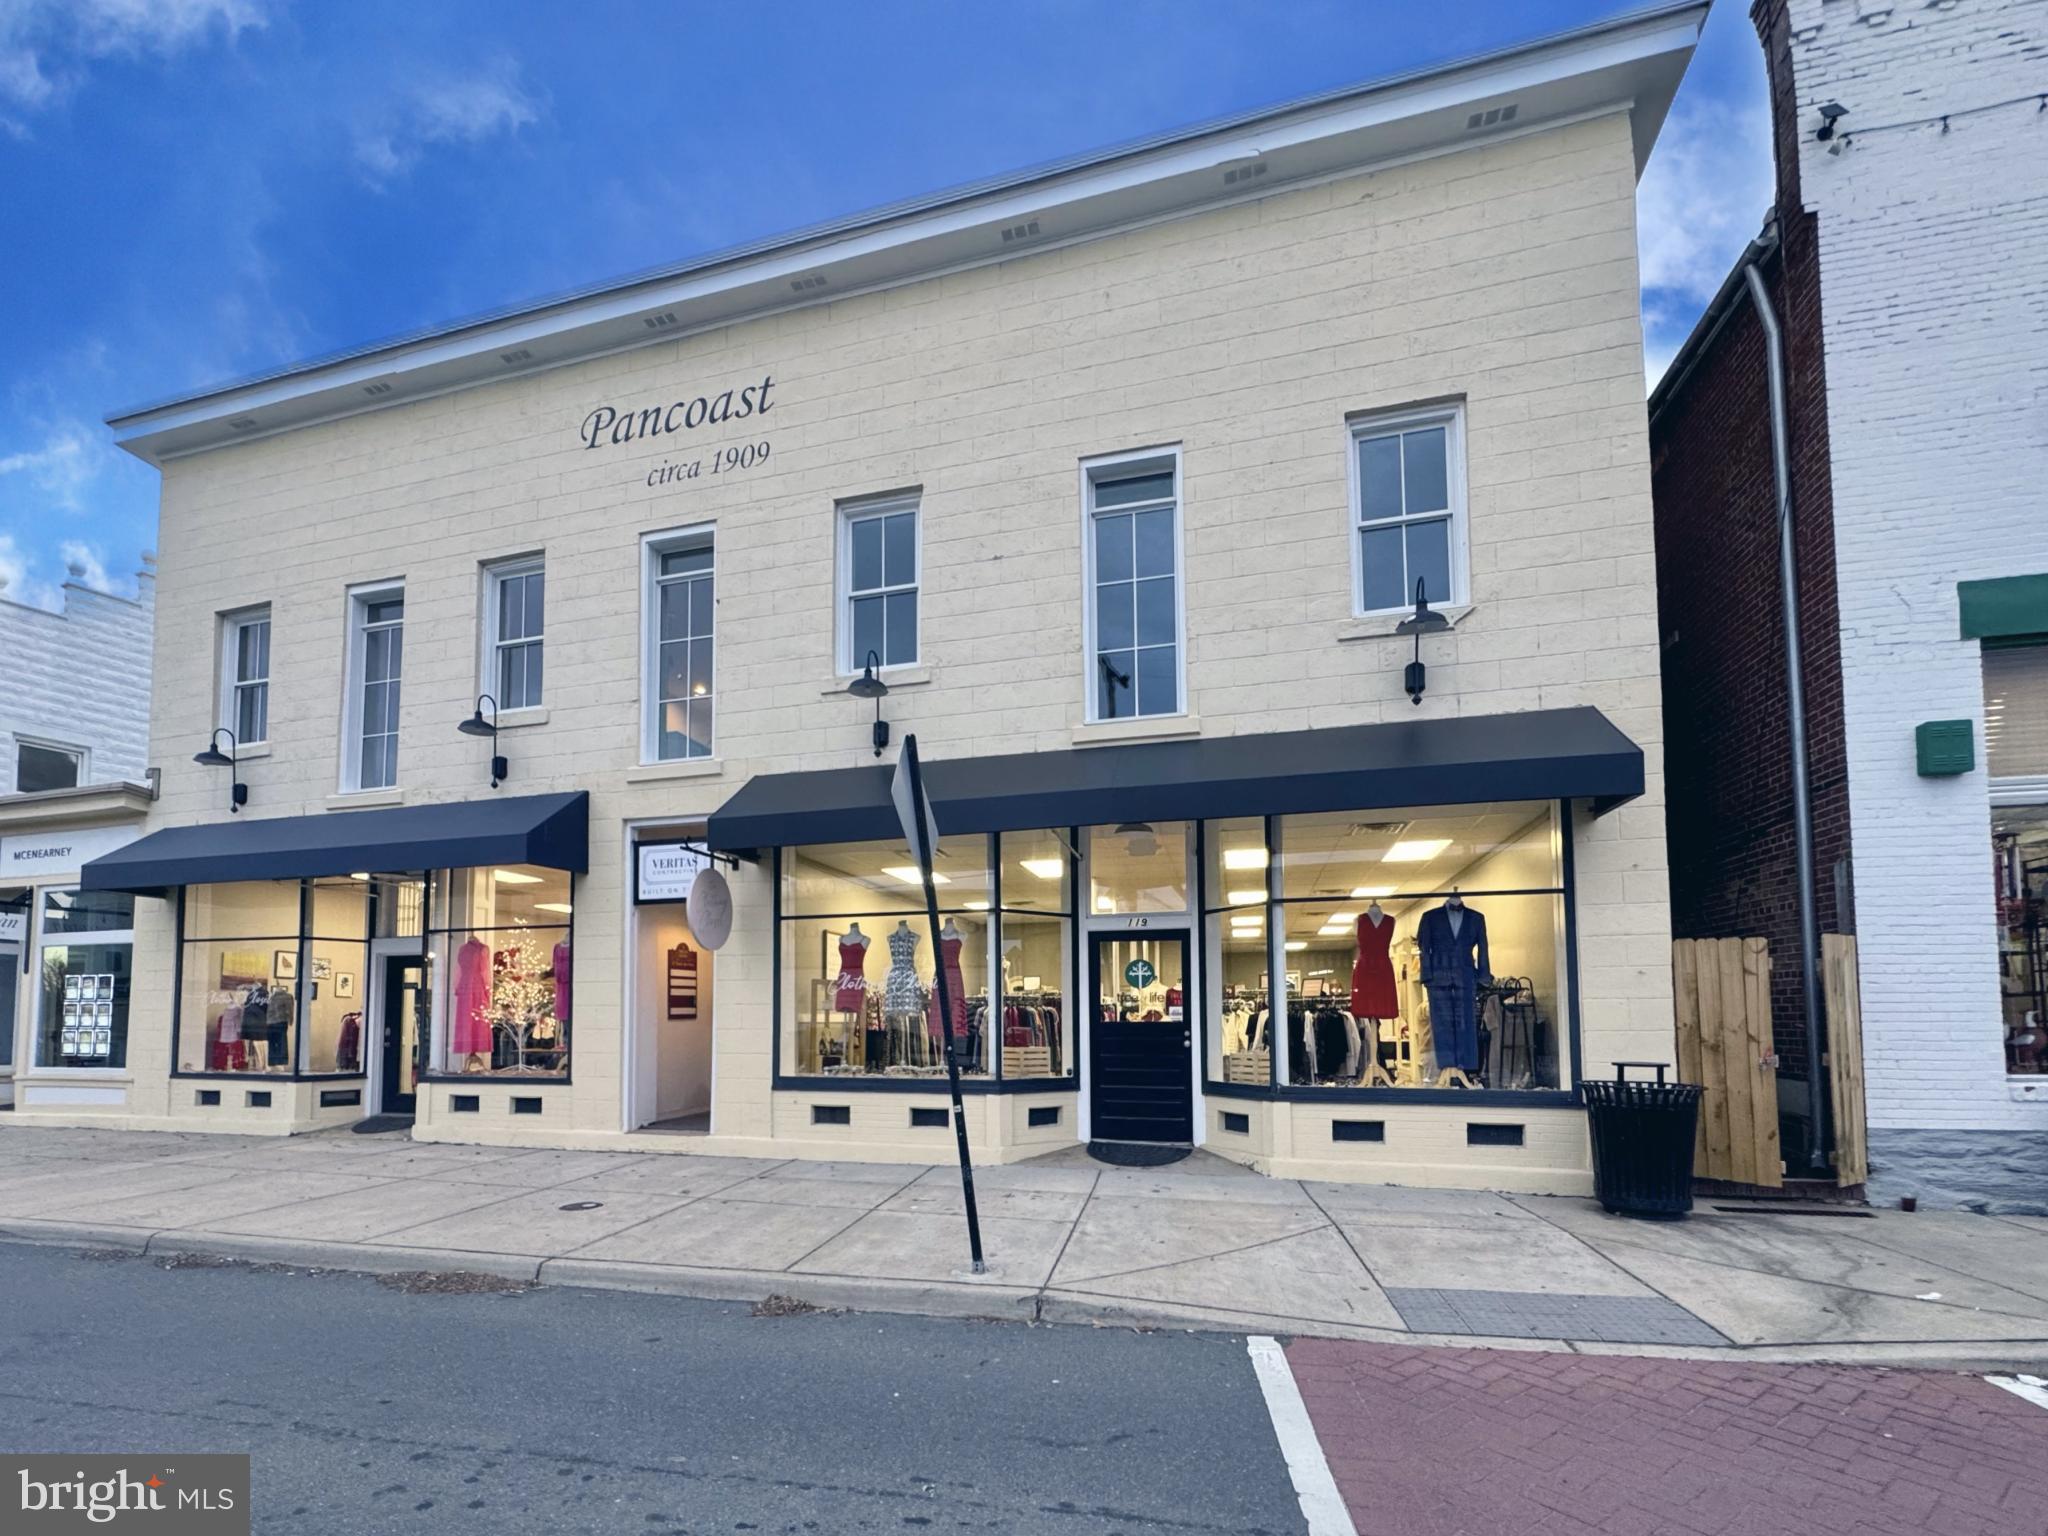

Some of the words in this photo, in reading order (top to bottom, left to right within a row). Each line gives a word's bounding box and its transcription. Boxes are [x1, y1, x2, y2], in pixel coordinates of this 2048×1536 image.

[580, 375, 776, 450] Pancoast
[647, 459, 701, 487] circa
[710, 440, 771, 475] 1909
[13, 846, 73, 860] MCENEARNEY
[652, 857, 698, 869] VERITAS
[1128, 918, 1148, 927] 119
[1149, 991, 1166, 1004] life
